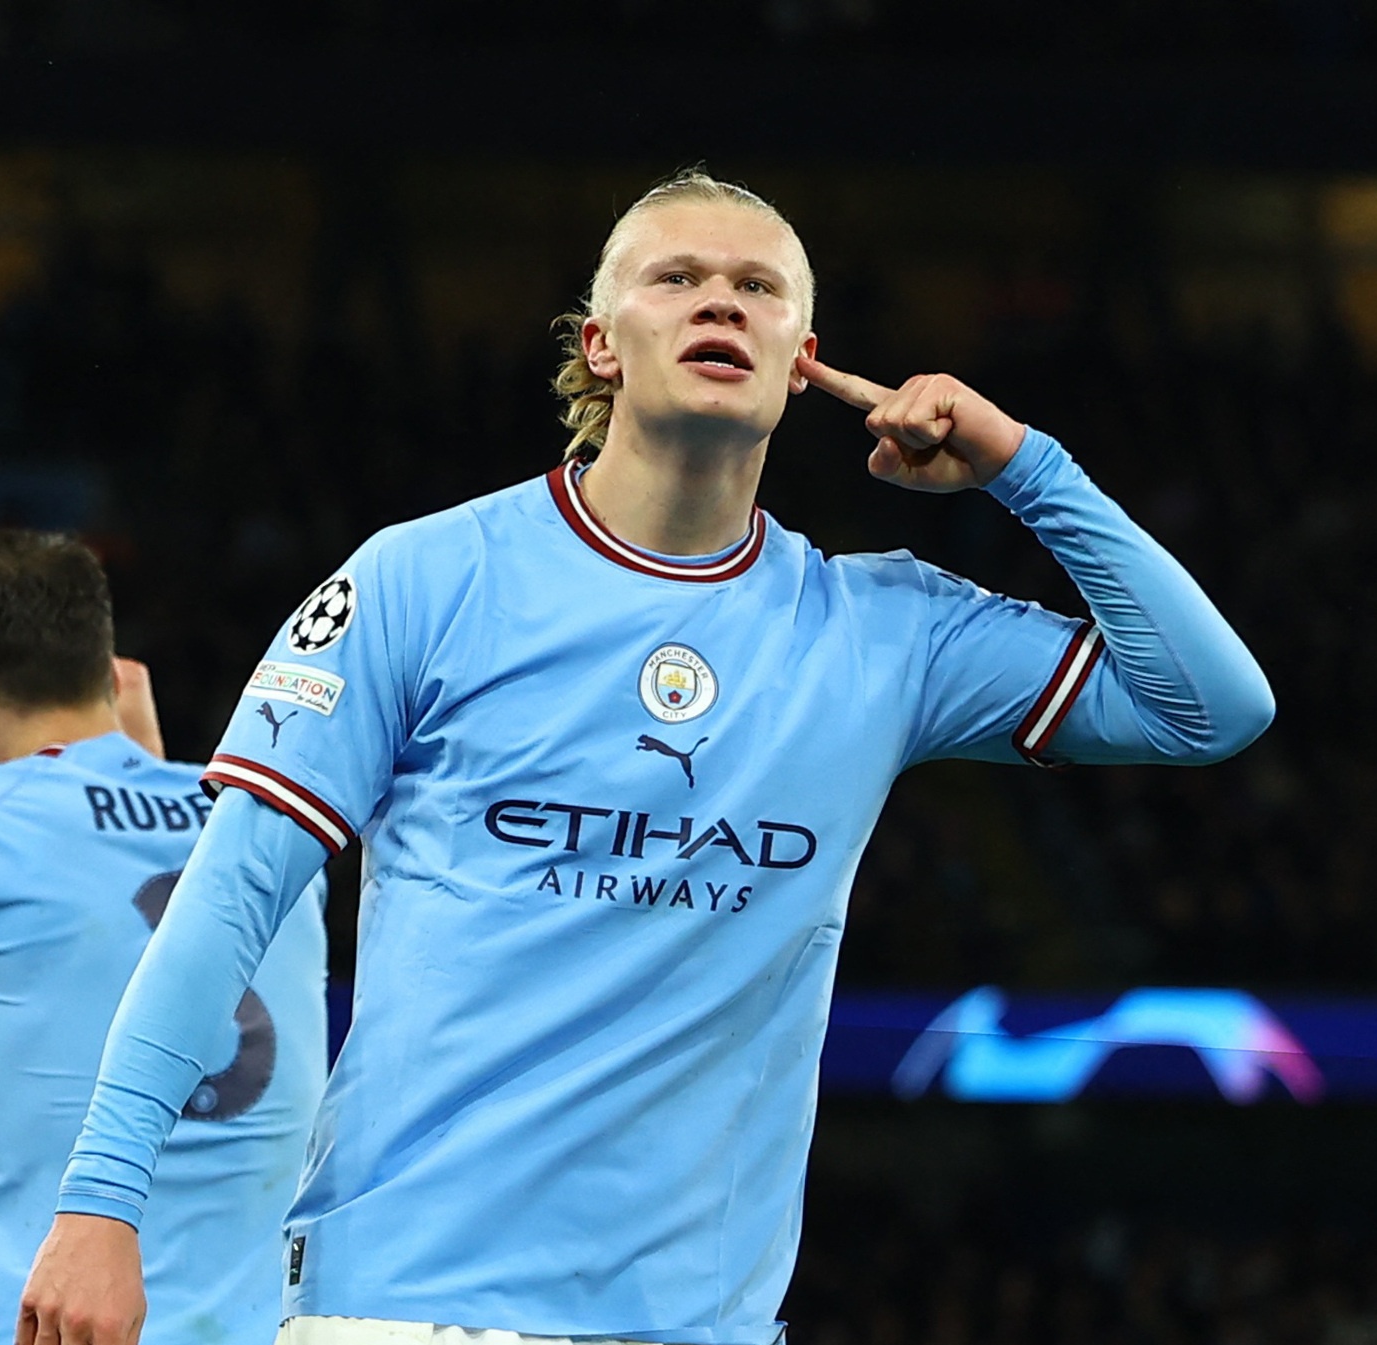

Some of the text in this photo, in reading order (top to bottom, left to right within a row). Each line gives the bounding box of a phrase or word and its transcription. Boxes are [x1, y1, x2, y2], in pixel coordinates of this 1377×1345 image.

[648, 648, 709, 680] MANCHESTER
[662, 710, 687, 719] CITY
[84, 784, 212, 832] RUBE
[484, 799, 817, 869] ETIHAD
[537, 865, 753, 913] AIRWAYS
